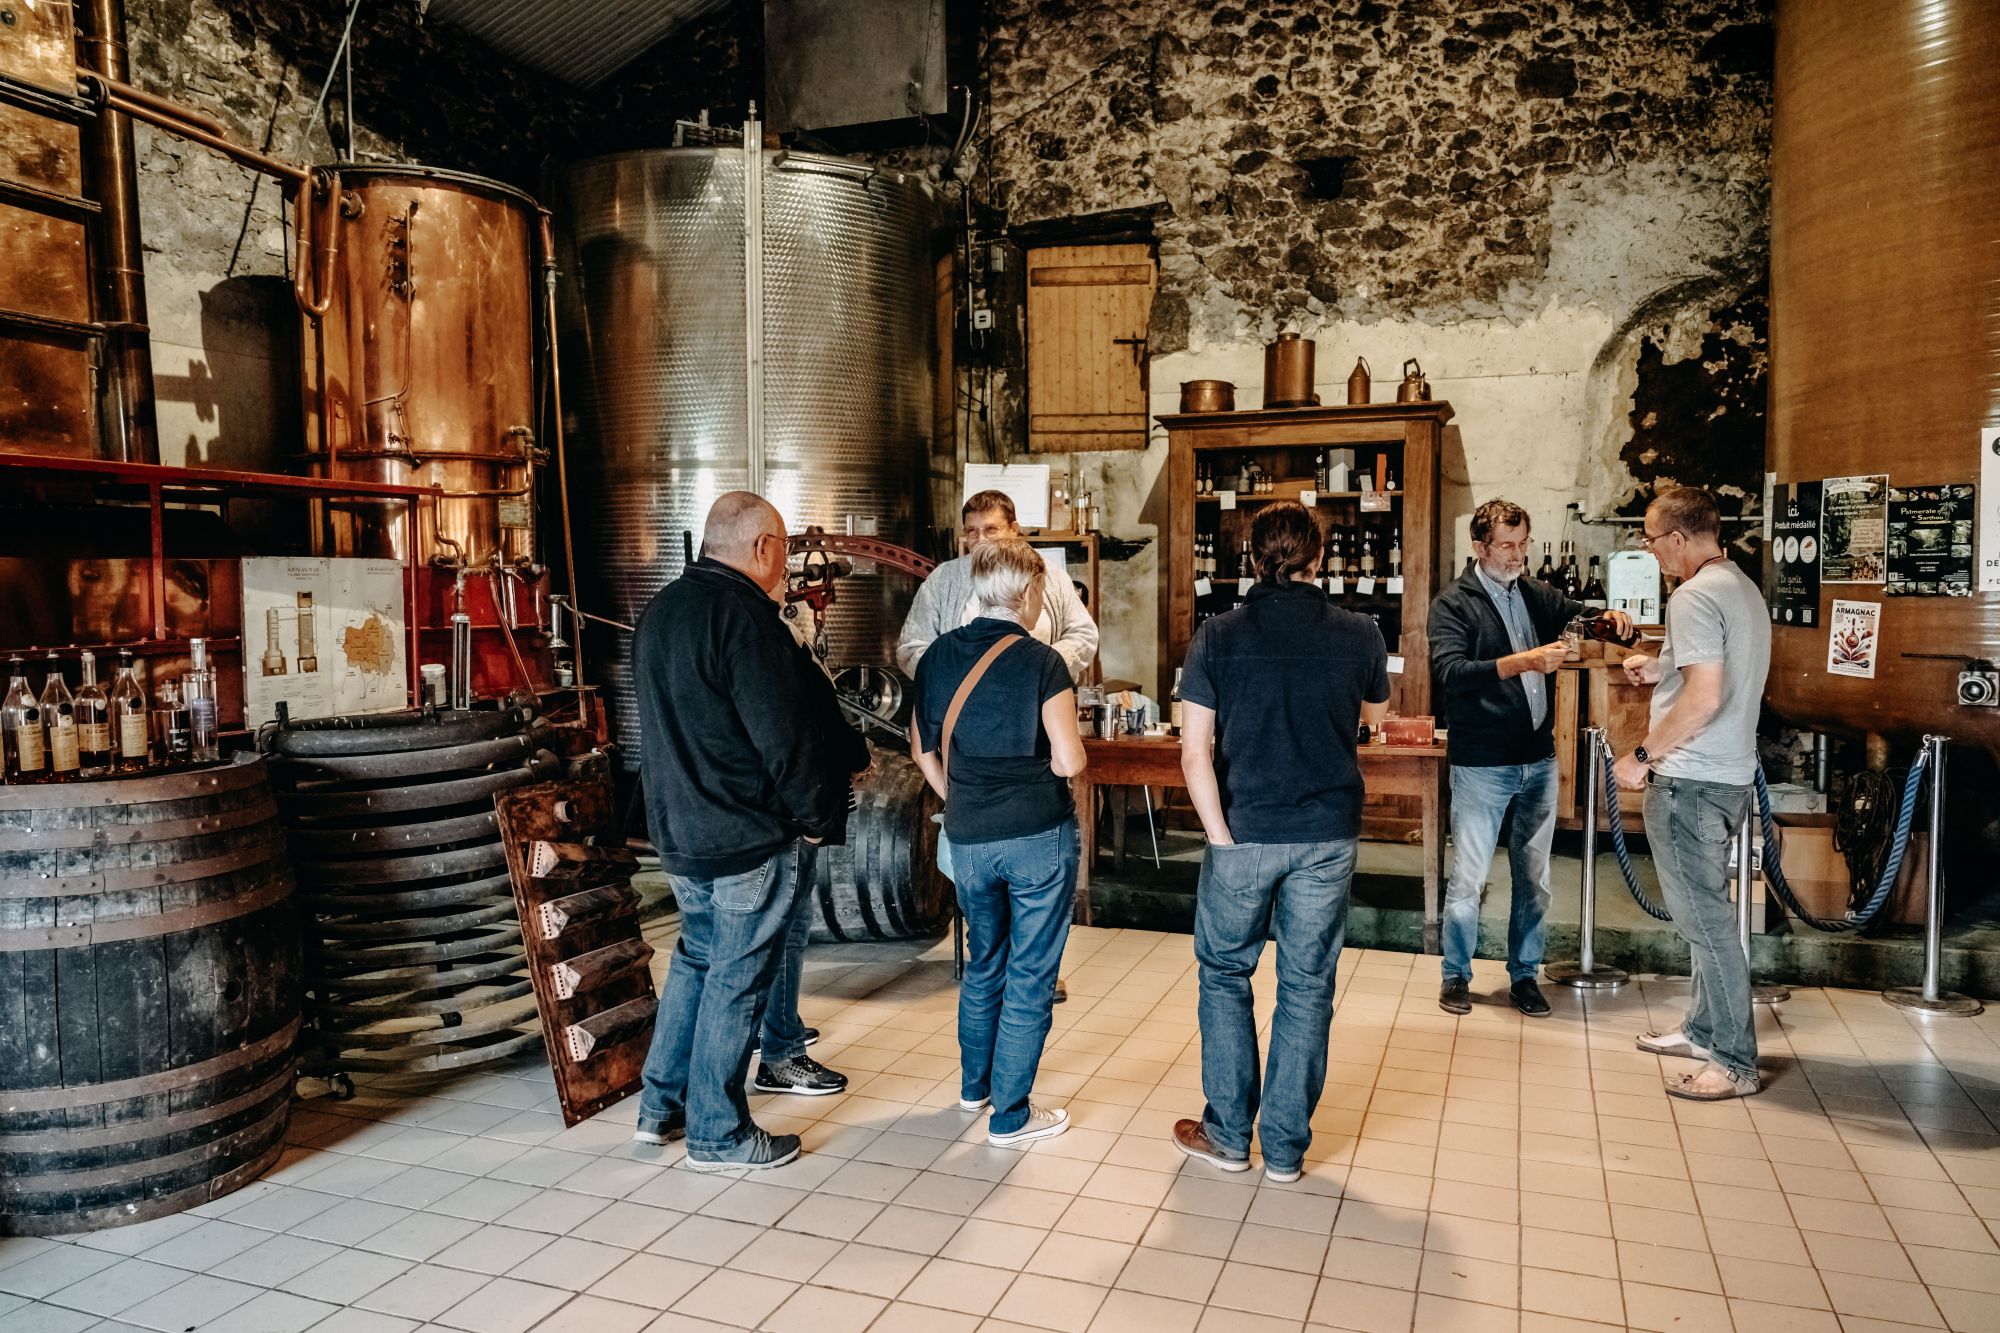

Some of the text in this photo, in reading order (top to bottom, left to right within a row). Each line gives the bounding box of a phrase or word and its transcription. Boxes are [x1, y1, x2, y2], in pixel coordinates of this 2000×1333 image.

[1788, 505, 1800, 517] ici
[1900, 507, 1936, 515] Palmeraie
[1774, 520, 1816, 529] Produit médaillé
[1836, 607, 1875, 616] ARMAGNAC
